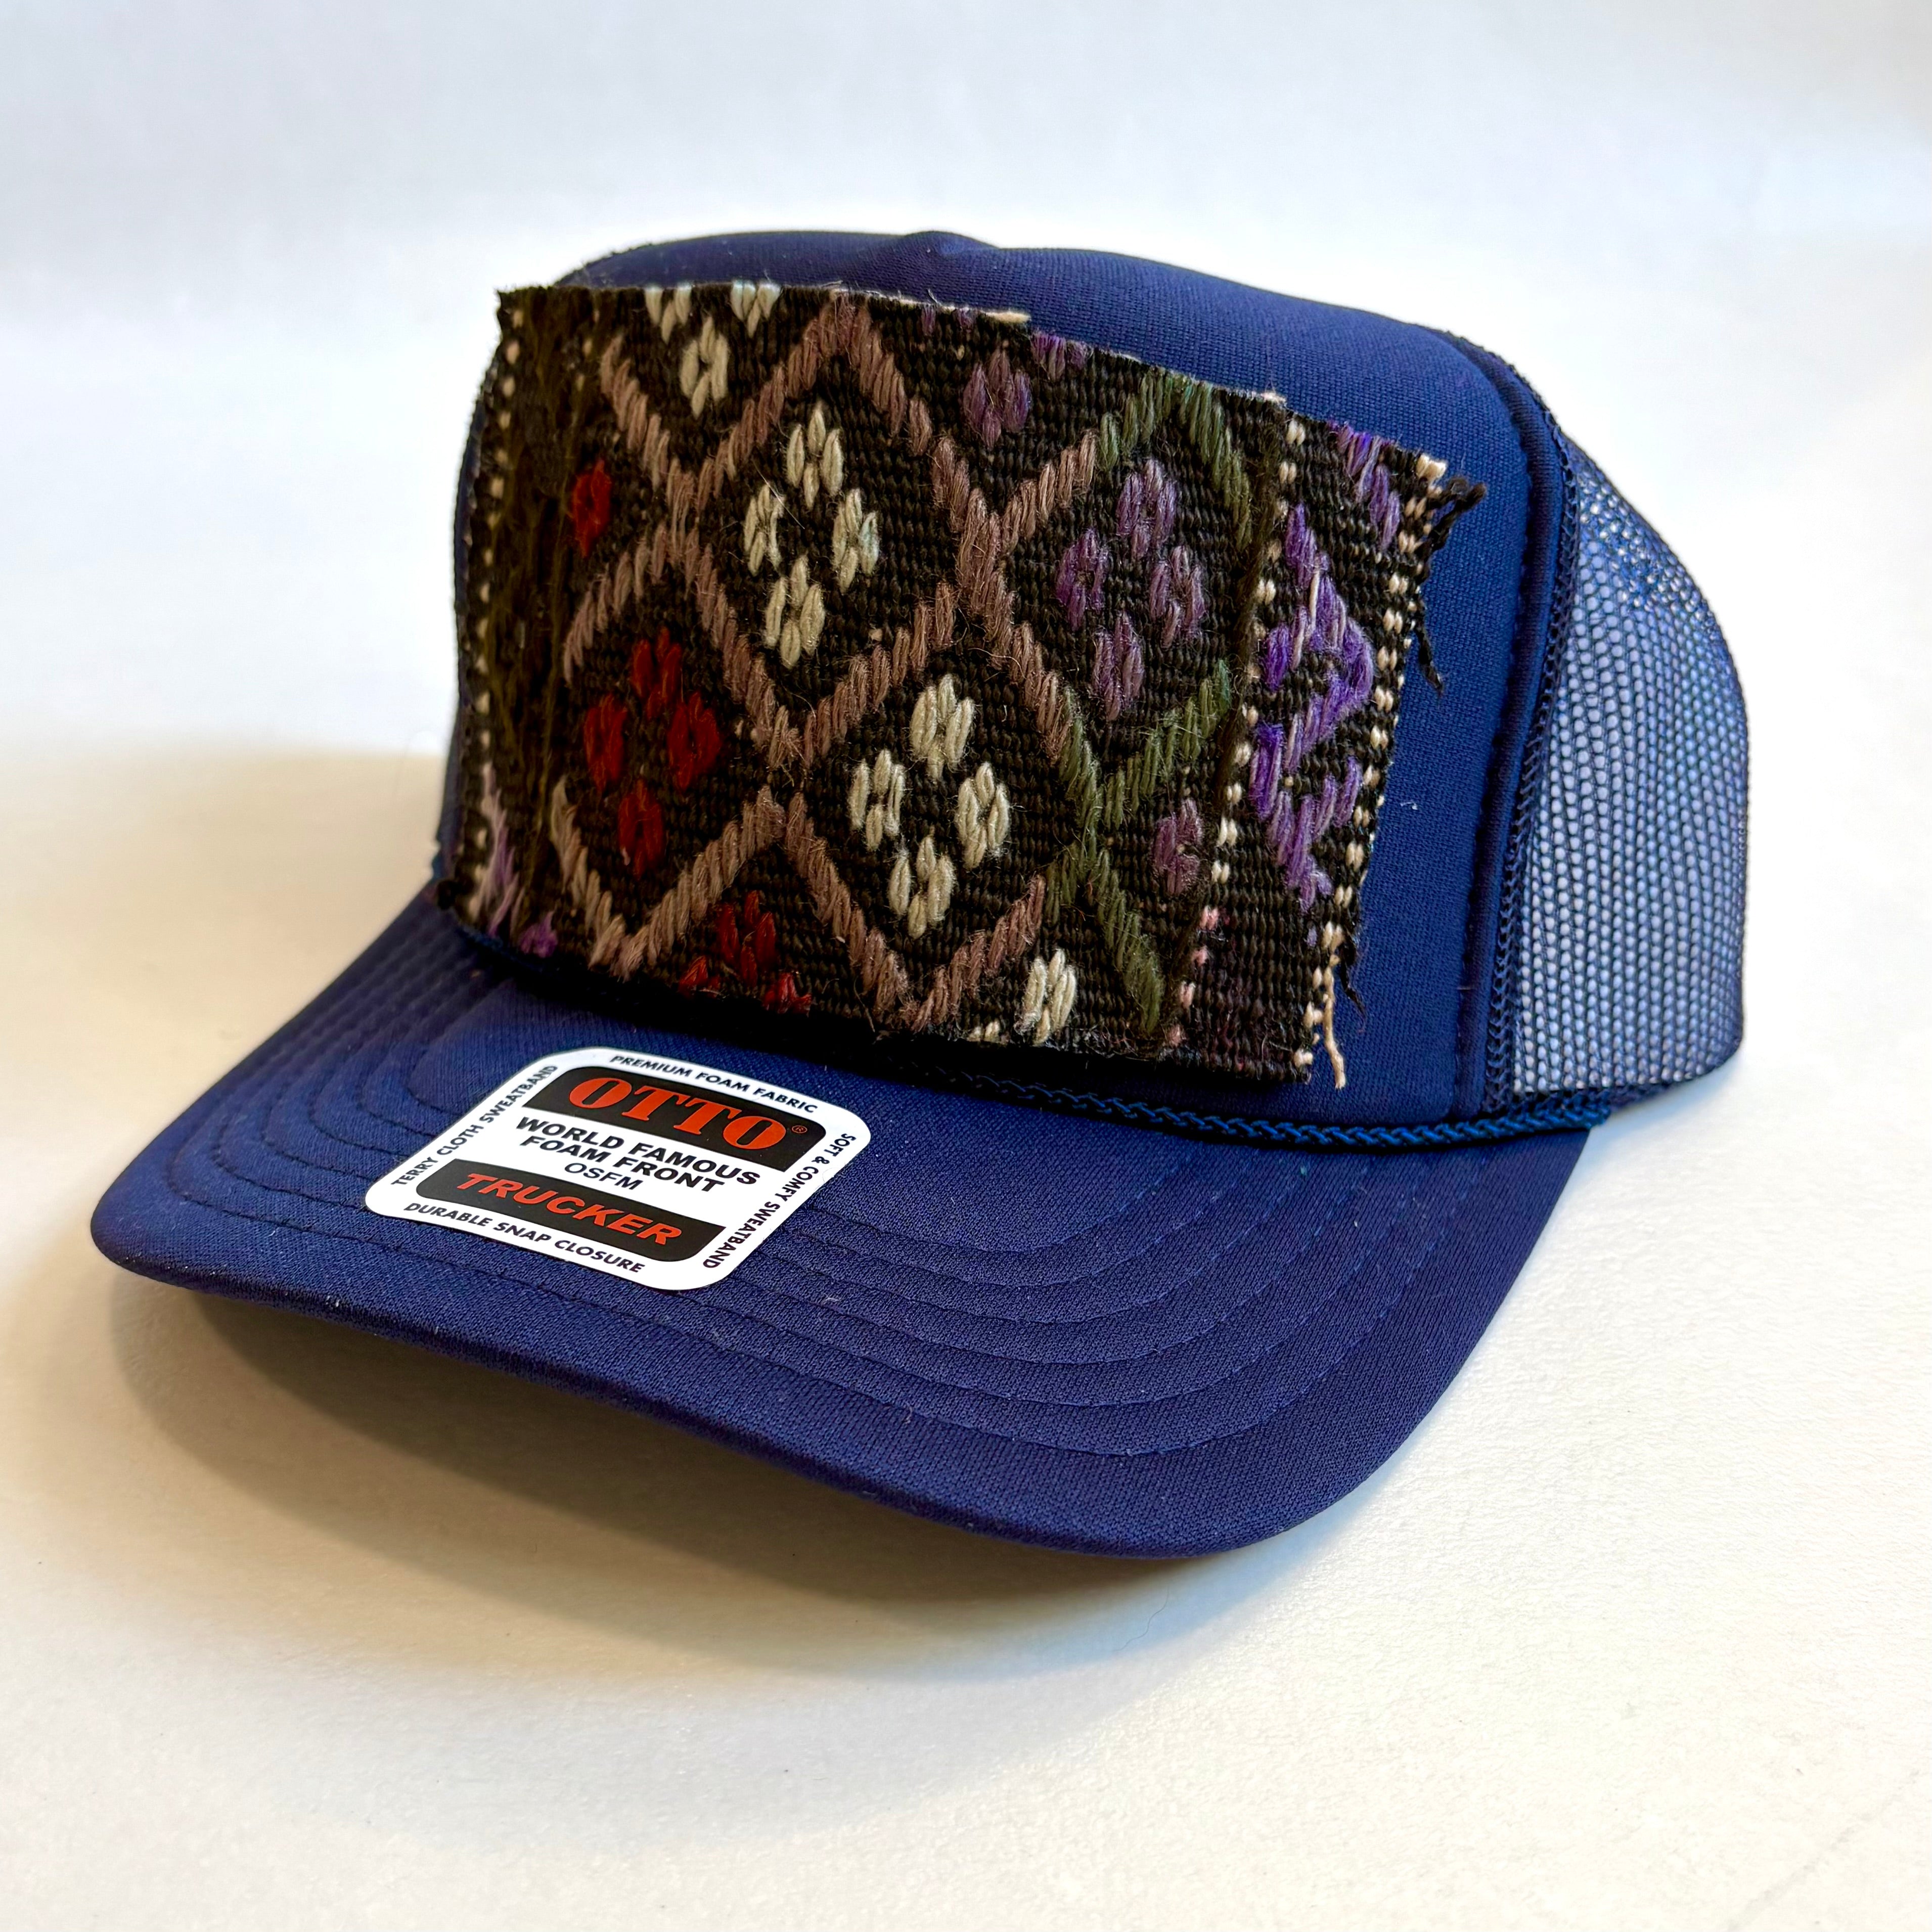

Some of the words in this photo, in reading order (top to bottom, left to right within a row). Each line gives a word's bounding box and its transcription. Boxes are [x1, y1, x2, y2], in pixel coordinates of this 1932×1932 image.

[610, 1055, 693, 1077] PREMIUM
[695, 1071, 750, 1092] FOAM
[753, 1087, 819, 1113] FABRIC
[391, 1156, 440, 1186] TERRY
[437, 1124, 484, 1156] CLOTH
[479, 1065, 559, 1124] SWEATBAND
[516, 1116, 625, 1149] WORLD
[628, 1142, 760, 1185] FAMOUS
[828, 1133, 857, 1164] SOFT
[520, 1136, 615, 1163] FOAM
[612, 1156, 725, 1192] FRONT
[564, 1163, 643, 1190] OSFM
[775, 1165, 819, 1202] COMFY
[812, 1156, 830, 1165] &
[403, 1202, 493, 1227] DURABLE
[493, 1222, 552, 1242] SNAP
[555, 1239, 646, 1273] CLOSURE
[457, 1173, 682, 1245] TRUCKER
[702, 1201, 780, 1269] SWEATBAND
